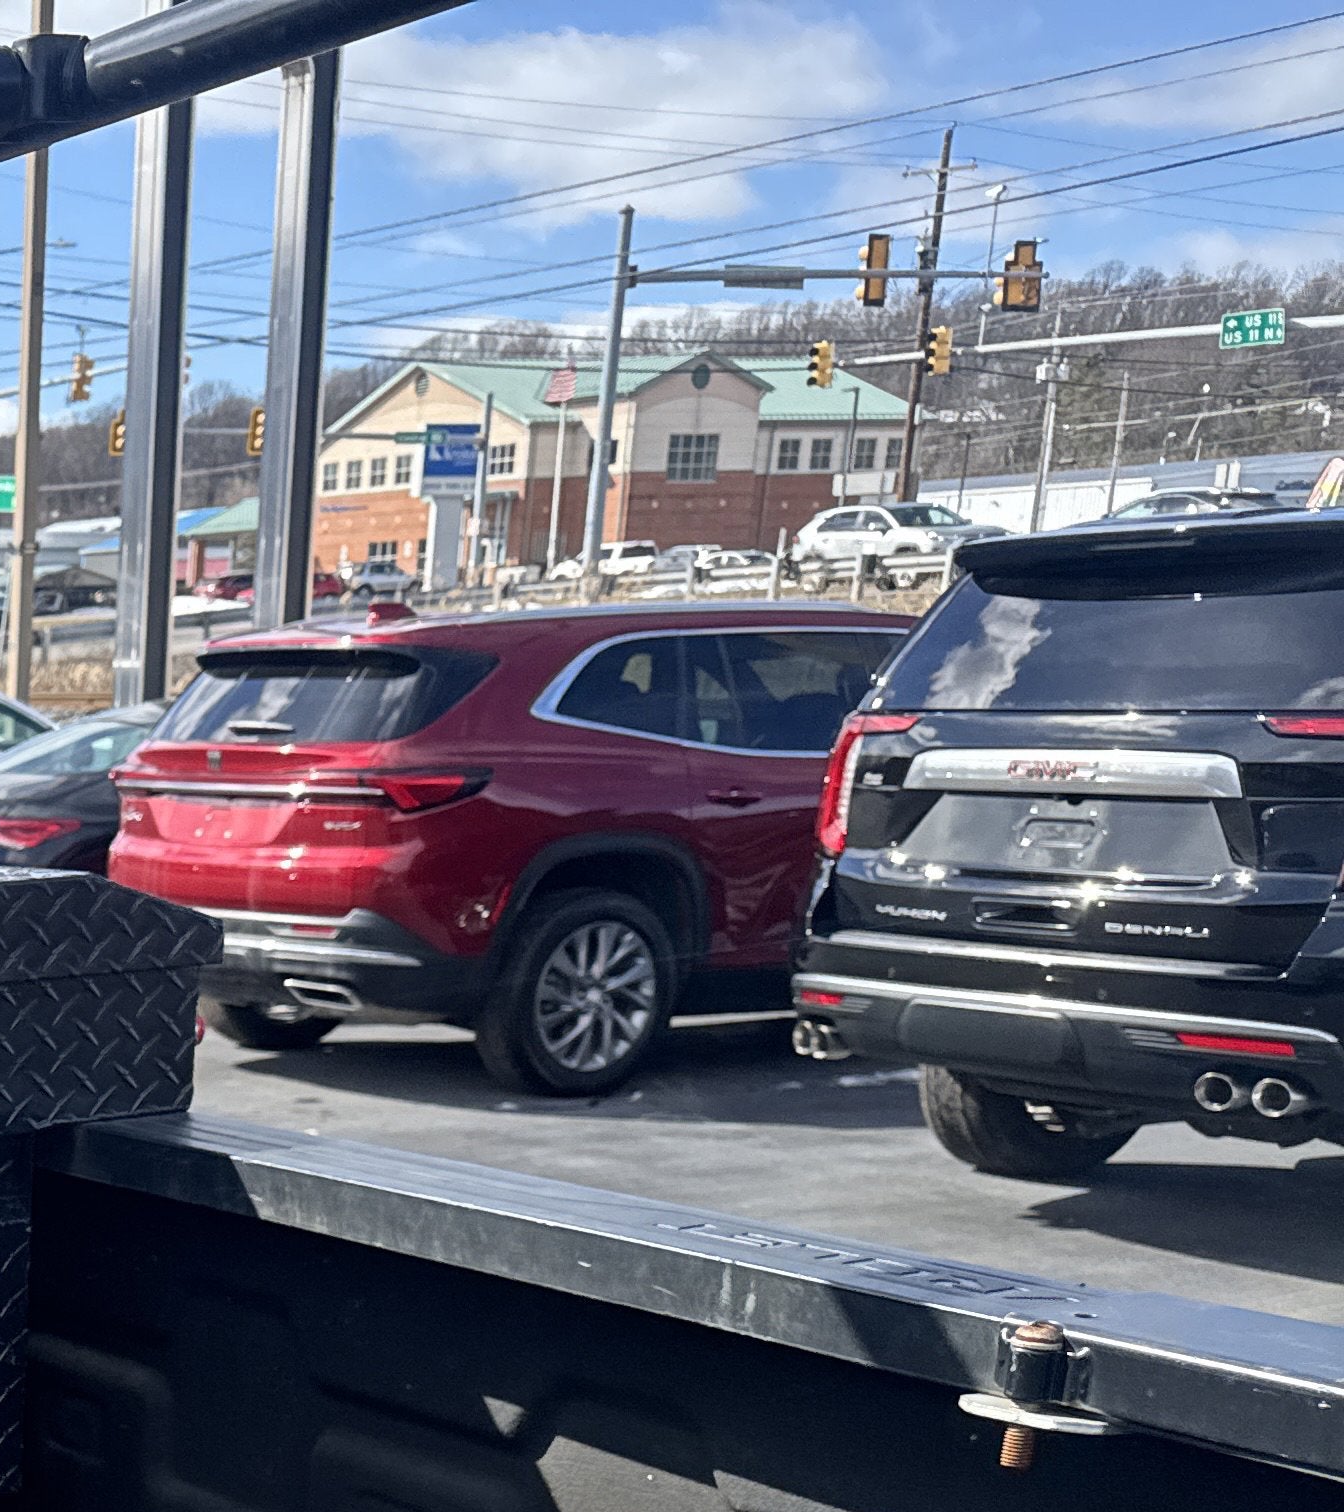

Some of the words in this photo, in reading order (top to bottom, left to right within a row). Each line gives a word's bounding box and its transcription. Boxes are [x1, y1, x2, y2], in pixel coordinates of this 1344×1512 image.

[1245, 314, 1262, 328] US
[1224, 330, 1243, 344] US
[1249, 329, 1259, 341] 11
[1008, 760, 1099, 781] GMC
[1104, 921, 1210, 939] DENALI
